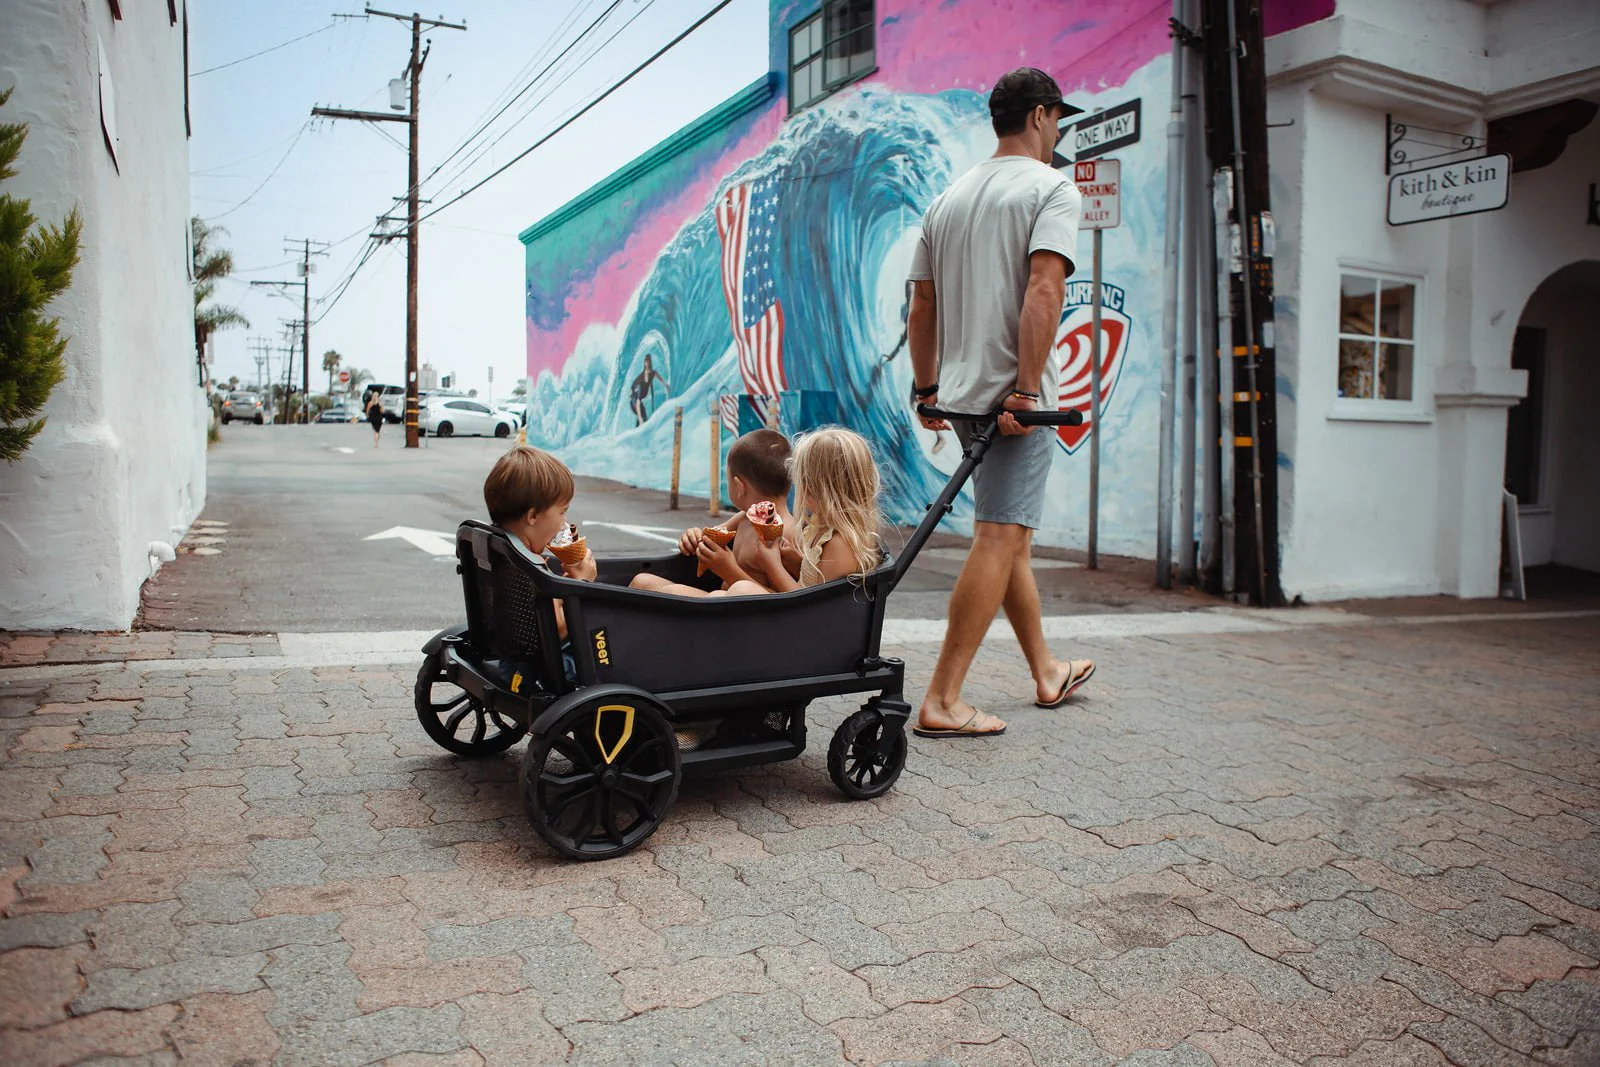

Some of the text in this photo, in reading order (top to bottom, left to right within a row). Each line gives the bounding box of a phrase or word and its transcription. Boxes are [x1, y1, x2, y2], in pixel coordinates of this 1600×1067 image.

[1075, 115, 1131, 150] ONE WAY
[1077, 163, 1093, 180] NO
[1400, 166, 1497, 198] kith & kin
[1085, 210, 1110, 221] ALLEY
[1093, 199, 1102, 208] IN
[1421, 193, 1475, 215] boutique
[1064, 281, 1123, 311] URFNG
[595, 630, 610, 665] veer
